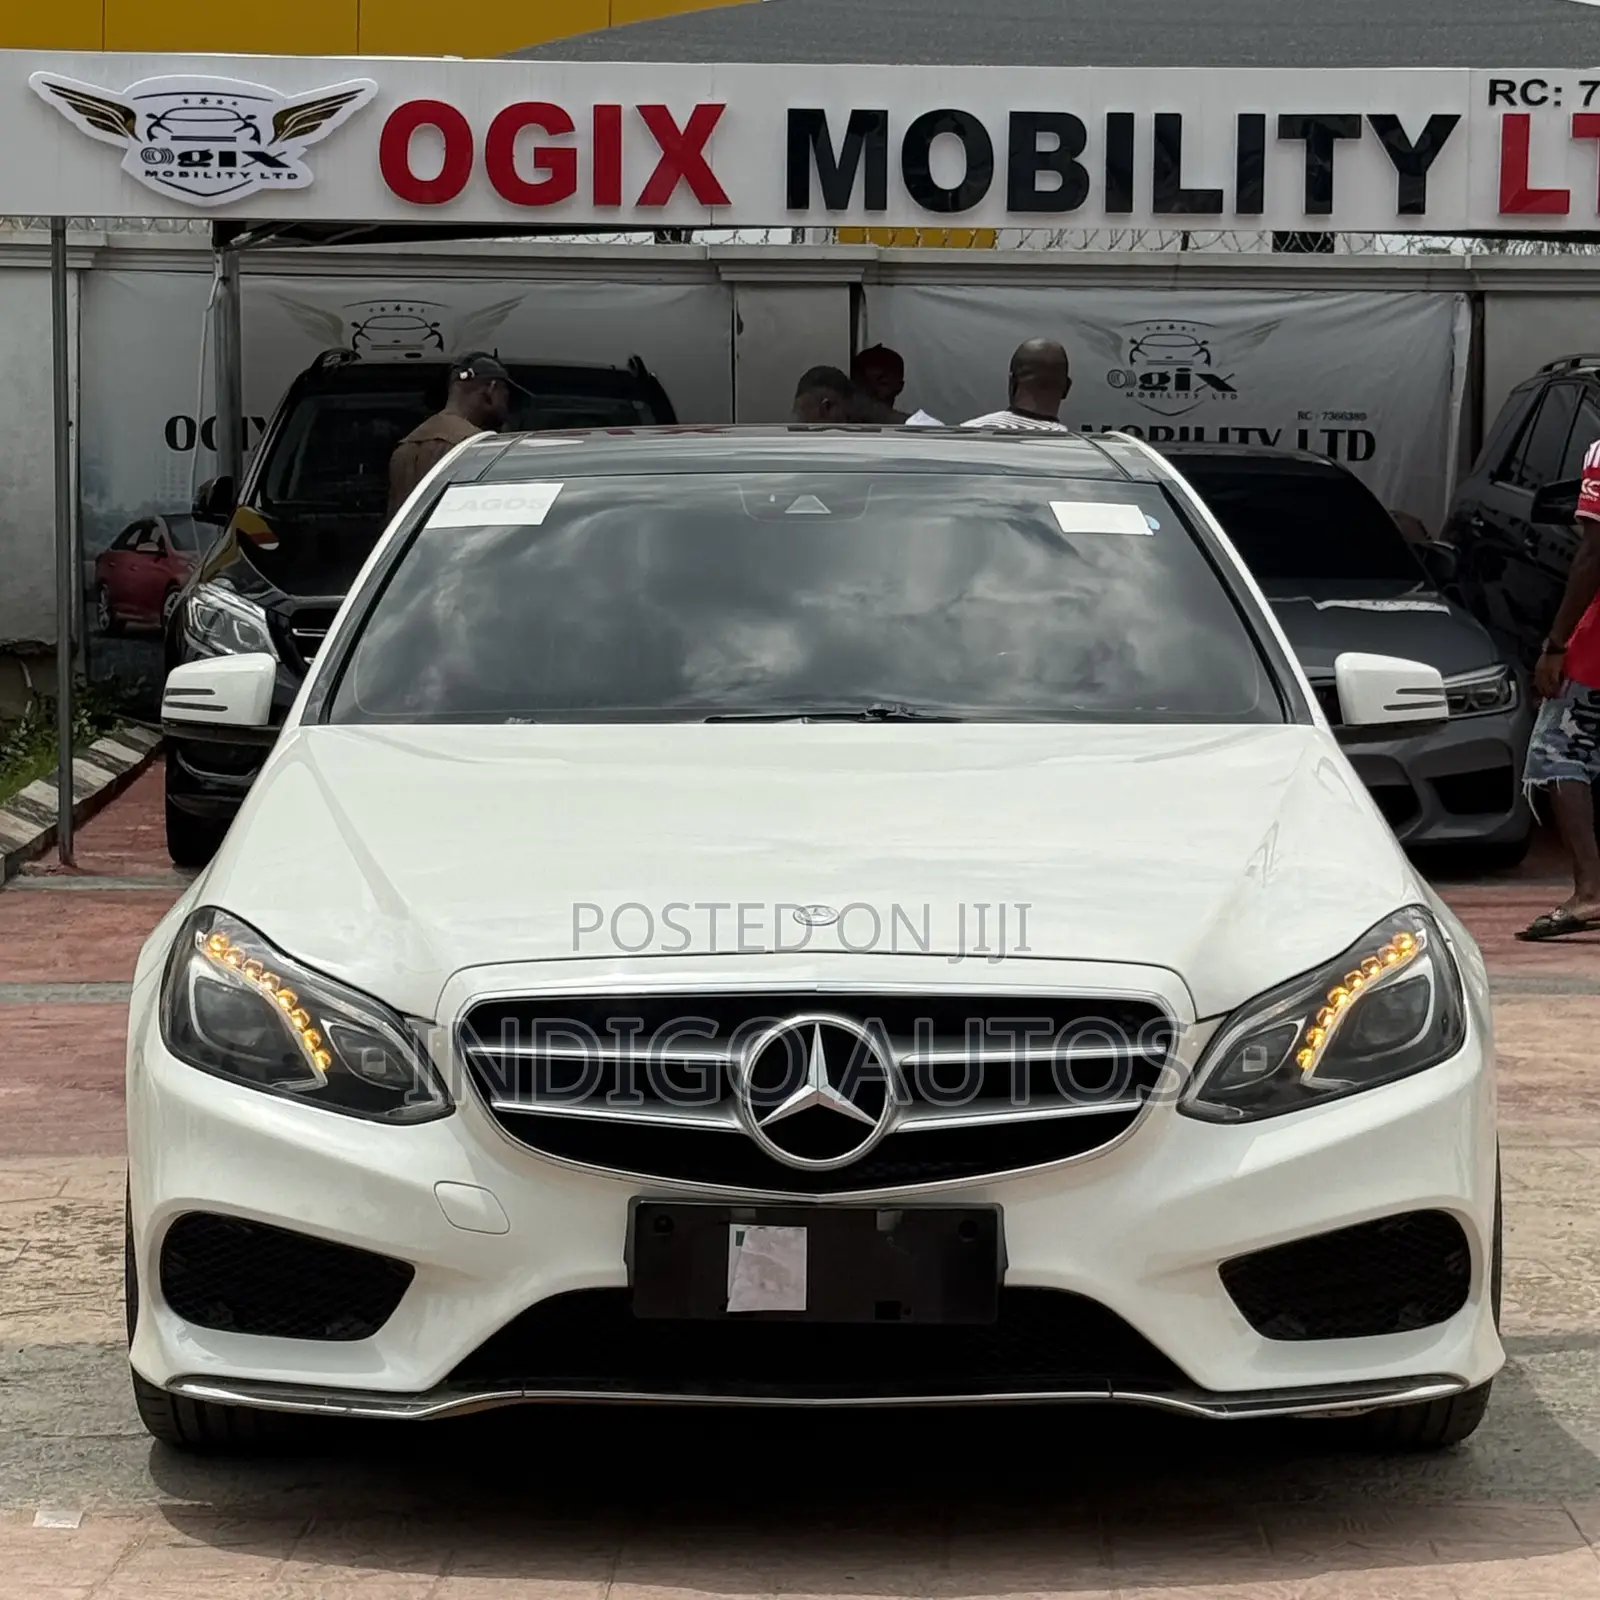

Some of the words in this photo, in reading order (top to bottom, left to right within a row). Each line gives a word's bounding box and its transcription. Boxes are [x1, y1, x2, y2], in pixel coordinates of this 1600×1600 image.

[1488, 78, 1562, 107] RC:
[379, 99, 732, 207] OGIX
[787, 108, 1461, 214] MOBILITY
[144, 169, 251, 180] MOBILITY
[259, 172, 299, 181] LTD
